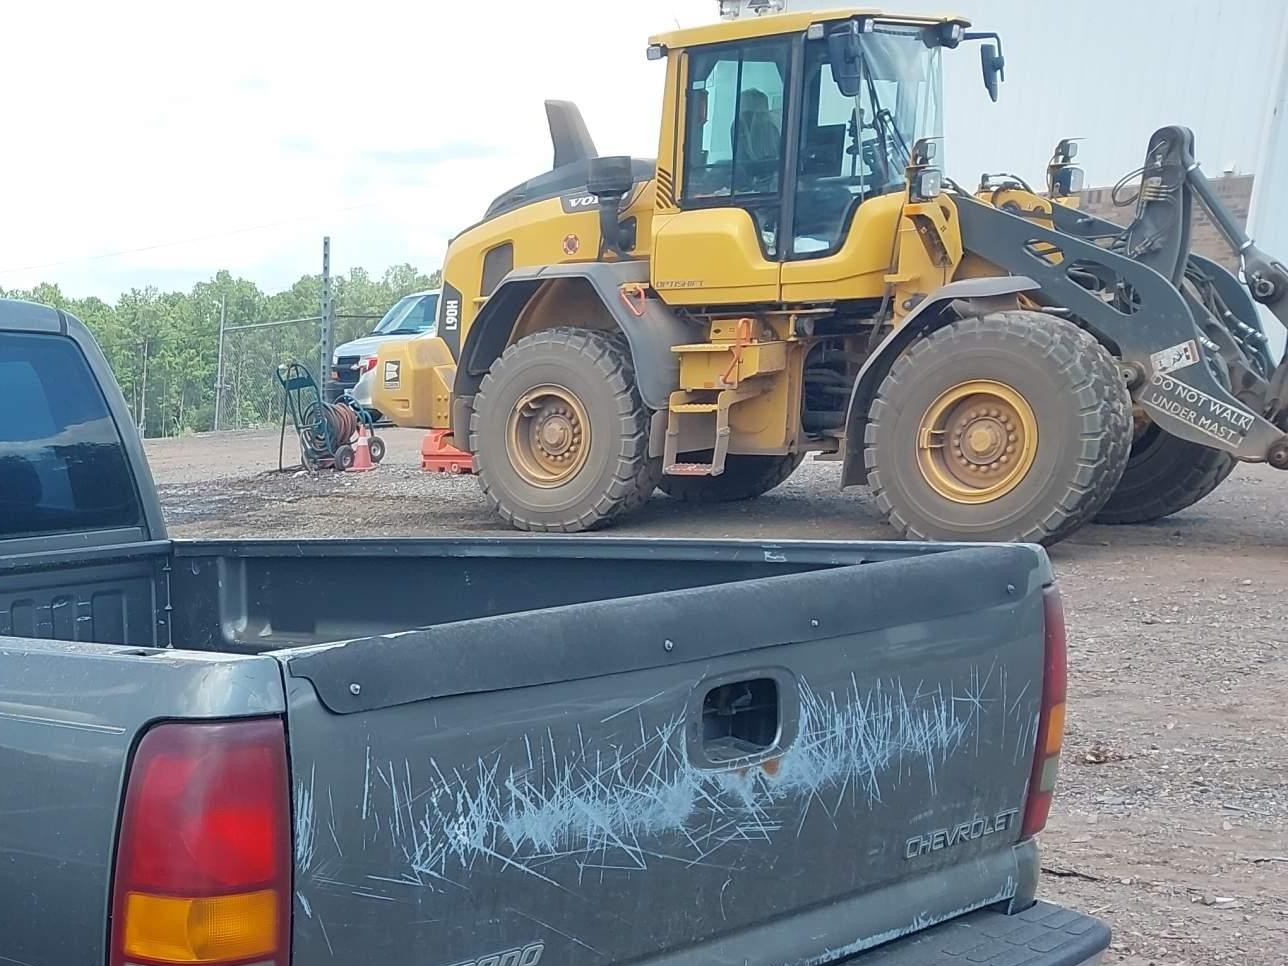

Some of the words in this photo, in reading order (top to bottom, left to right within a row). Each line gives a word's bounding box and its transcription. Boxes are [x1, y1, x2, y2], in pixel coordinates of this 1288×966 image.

[445, 300, 459, 330] L90H
[1151, 393, 1197, 422] UNDER
[1198, 415, 1237, 441] MAST
[1153, 374, 1174, 391] DO
[1175, 386, 1208, 407] NOT
[1209, 400, 1250, 429] WALK
[906, 808, 1019, 859] CHEVROLET
